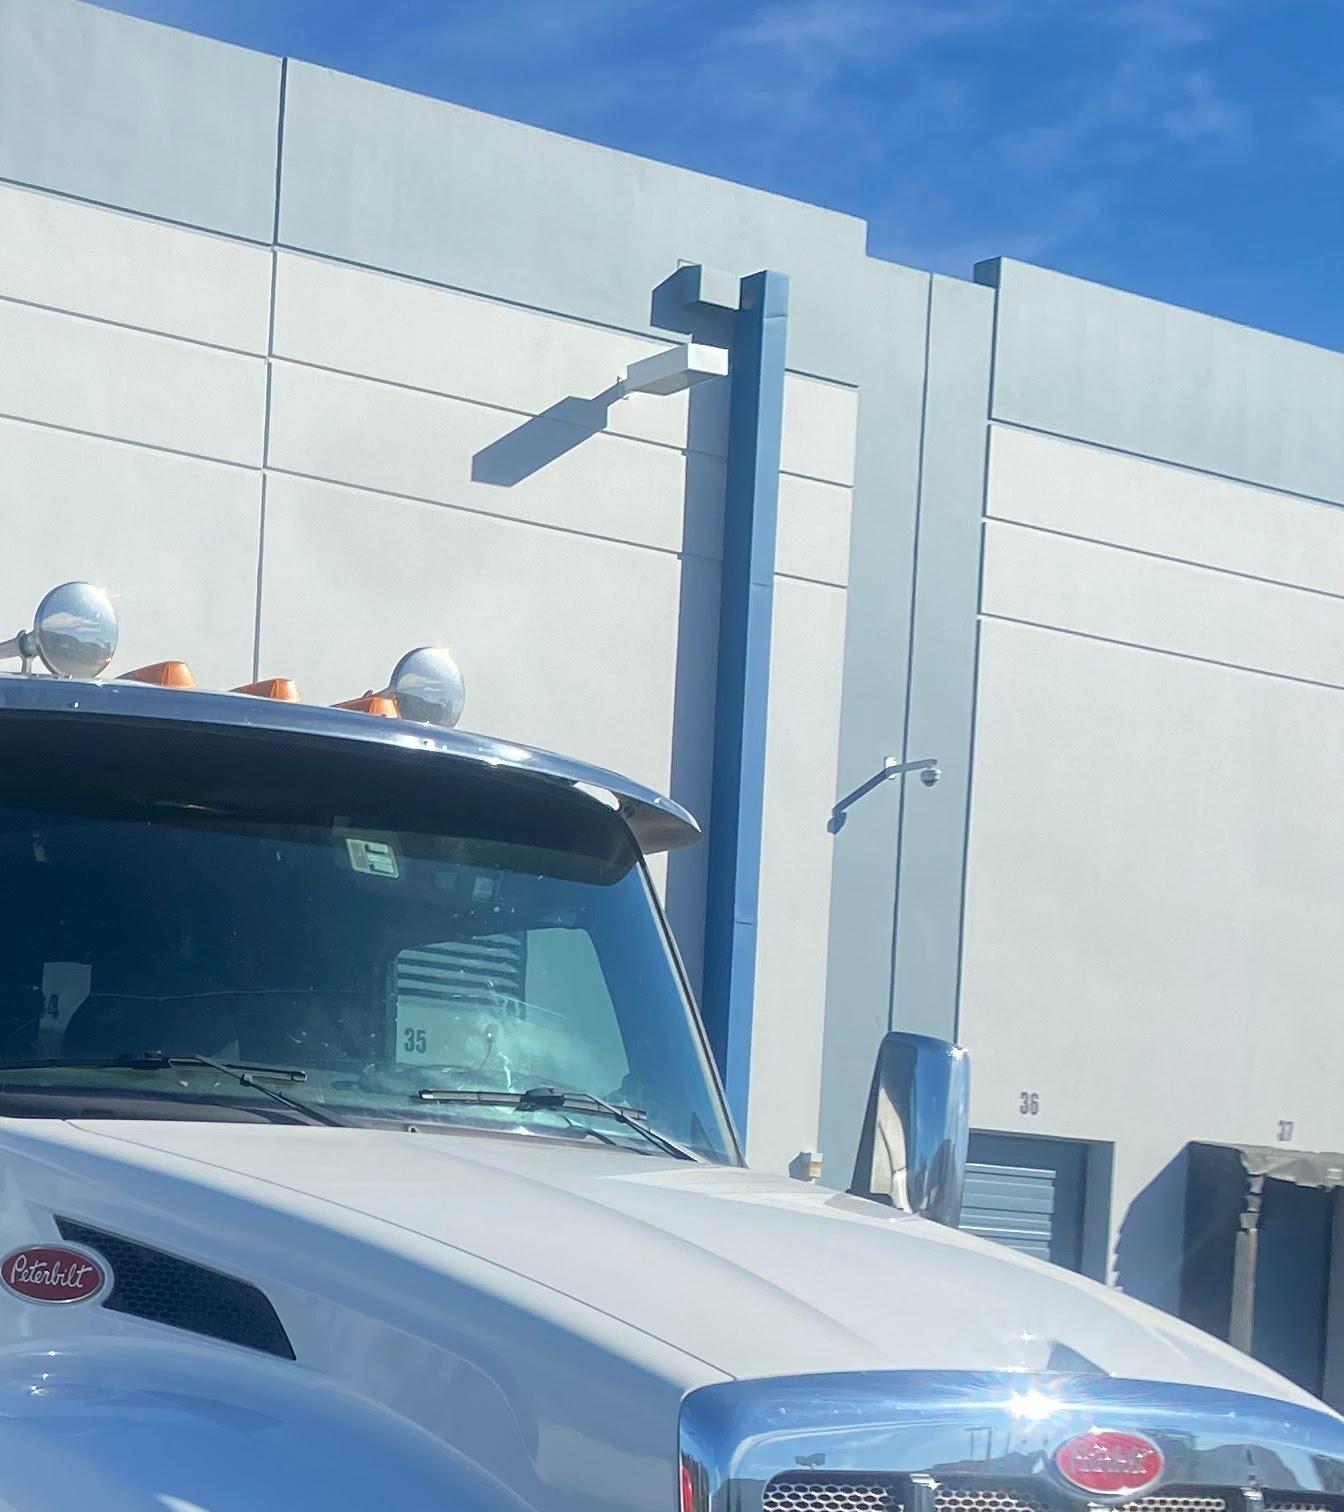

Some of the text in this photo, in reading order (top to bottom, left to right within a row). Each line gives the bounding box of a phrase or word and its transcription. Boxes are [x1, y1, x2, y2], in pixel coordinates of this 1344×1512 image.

[404, 1027, 427, 1054] 35
[1019, 1091, 1039, 1115] 36
[10, 1254, 93, 1288] Peterbilt
